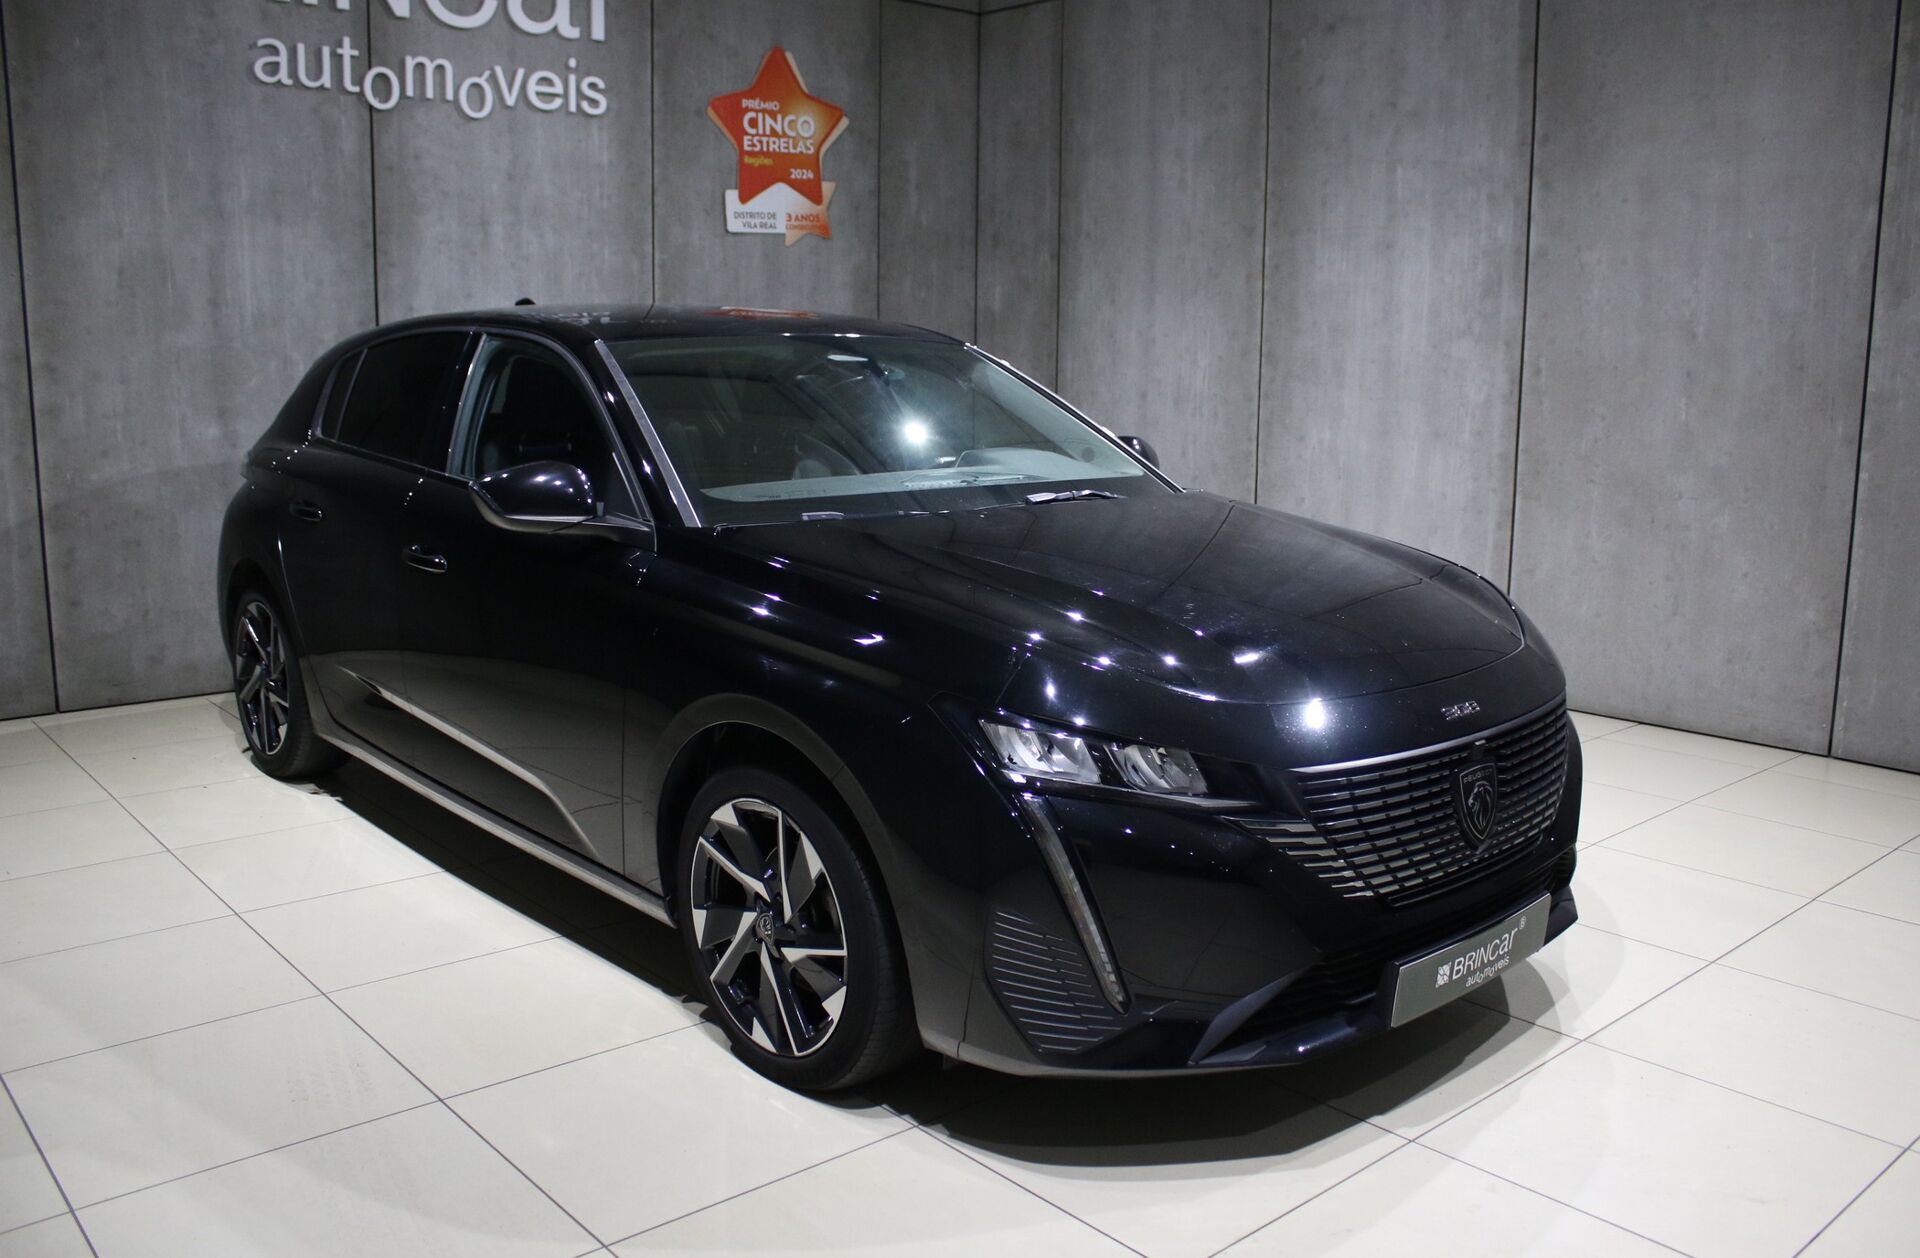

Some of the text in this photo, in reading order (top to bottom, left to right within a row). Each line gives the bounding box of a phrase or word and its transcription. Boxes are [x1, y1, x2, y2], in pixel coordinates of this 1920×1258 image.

[253, 36, 607, 119] automóveis
[742, 98, 779, 110] PRÉMIO
[743, 112, 815, 138] CINCO
[743, 136, 815, 154] ESTRELAS
[790, 169, 813, 179] 2024
[767, 212, 776, 221] DE
[786, 213, 821, 224] 3 ANOS
[1452, 927, 1518, 981] BRINCar
